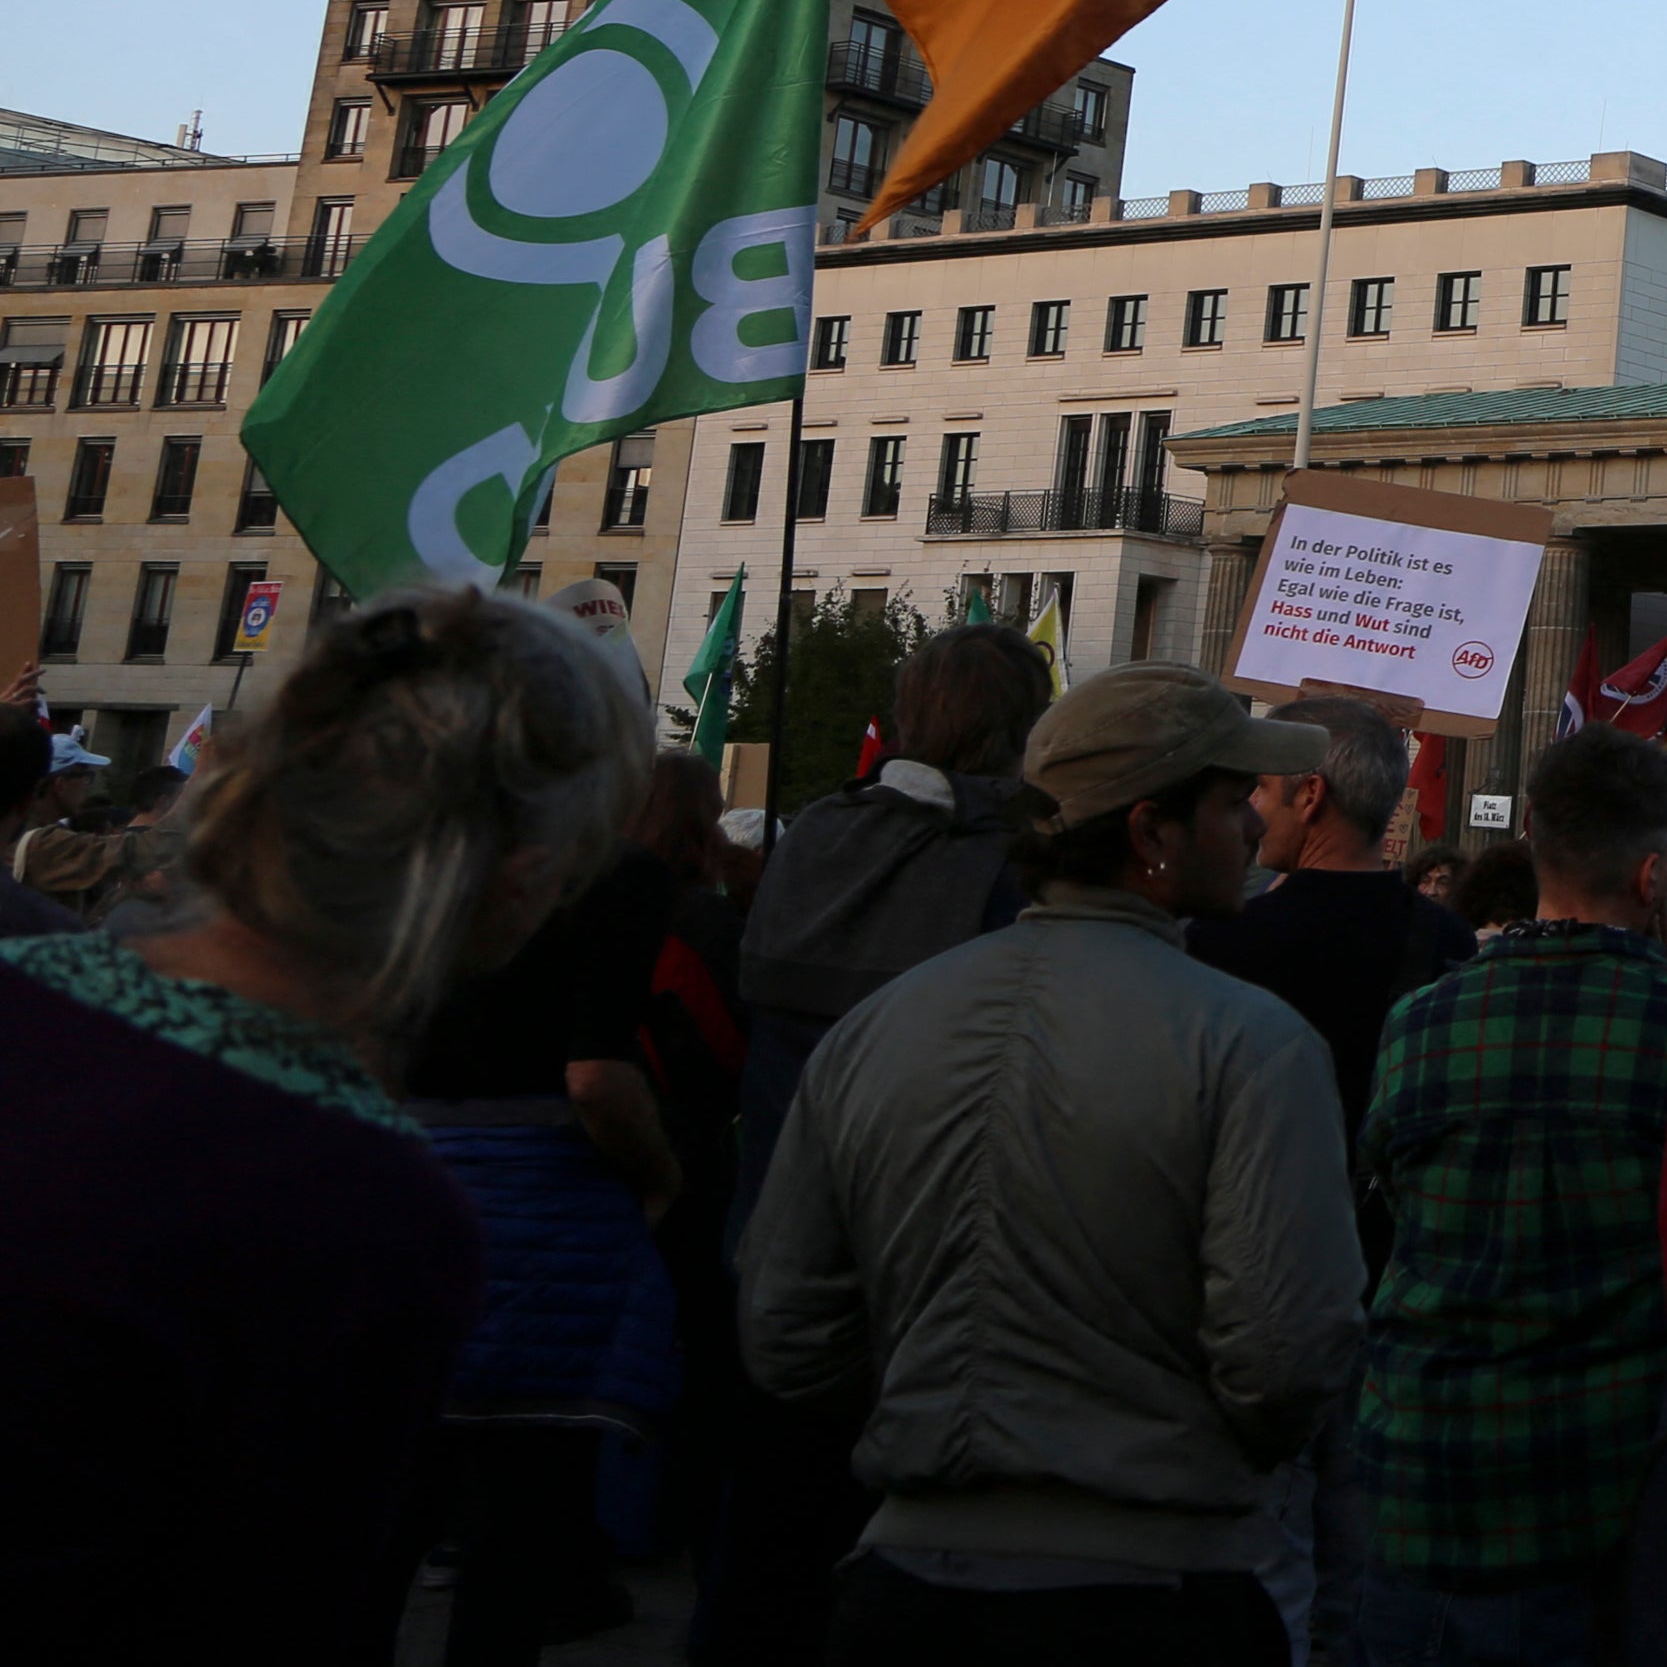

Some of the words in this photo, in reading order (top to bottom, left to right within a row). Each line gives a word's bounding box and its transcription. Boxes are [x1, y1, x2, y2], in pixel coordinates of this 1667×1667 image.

[1284, 558, 1314, 574] wie
[1319, 561, 1340, 578] im
[1344, 567, 1403, 589] Leben:
[1290, 535, 1307, 551] In
[1312, 540, 1342, 556] der
[1345, 545, 1403, 567] Politik
[1407, 554, 1429, 571] ist
[1433, 562, 1453, 575] es
[1271, 600, 1313, 619] Hass
[1316, 610, 1351, 624] und
[1355, 613, 1390, 632] Wut
[1393, 619, 1432, 638] sind
[1277, 579, 1315, 597] Egal
[1319, 585, 1349, 602] wie
[1353, 590, 1380, 608] die
[1385, 597, 1434, 618] Frage
[1438, 603, 1464, 625] ist,
[1264, 621, 1308, 641] nicht
[1312, 629, 1340, 645] die
[1343, 634, 1416, 659] Antwort
[1456, 650, 1489, 669] AfD
